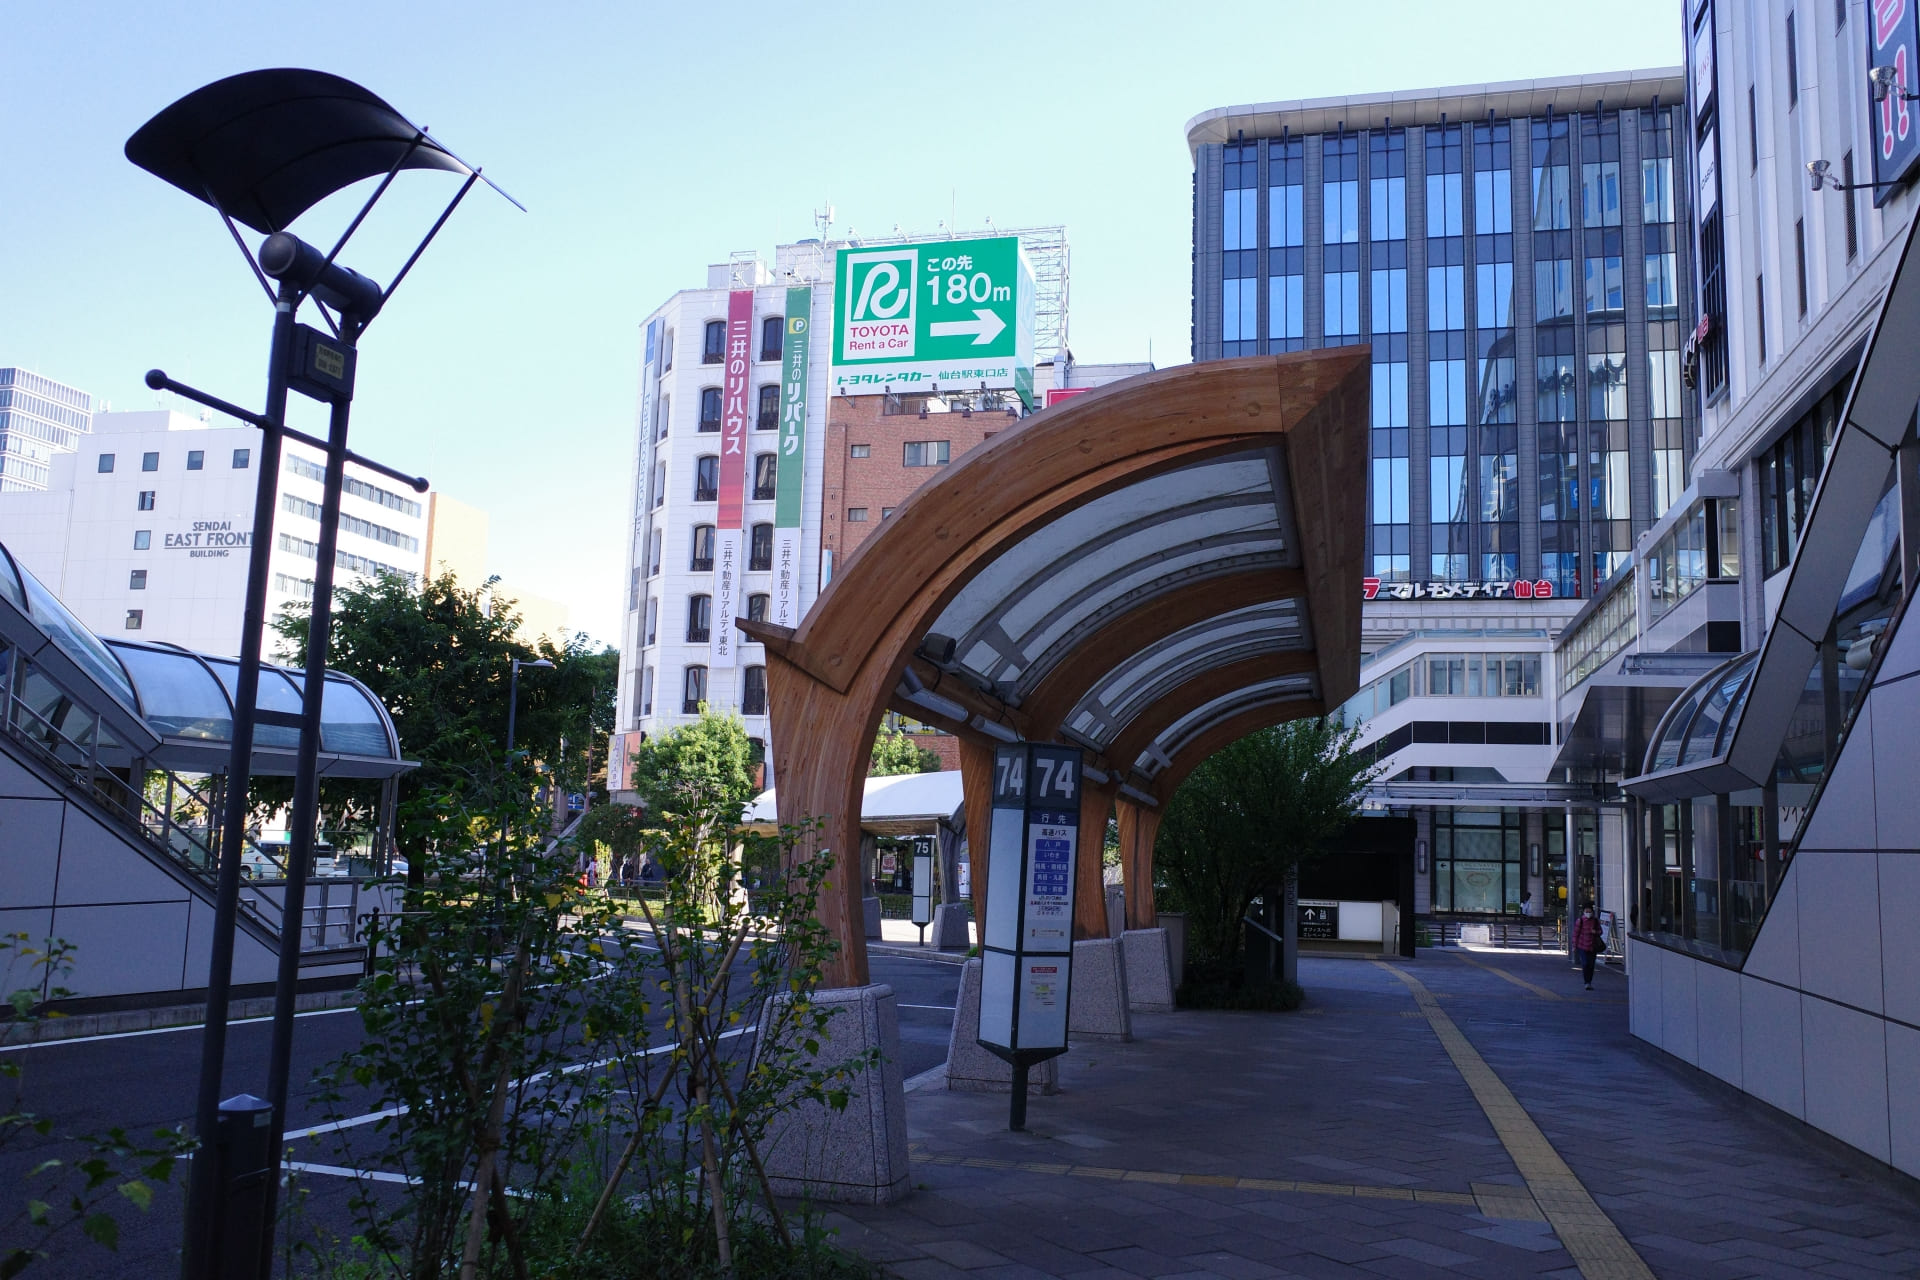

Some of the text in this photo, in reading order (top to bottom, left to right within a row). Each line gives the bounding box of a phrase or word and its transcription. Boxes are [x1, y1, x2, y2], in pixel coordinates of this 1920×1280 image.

[927, 255, 973, 272] この先
[926, 272, 1011, 305] 180m
[850, 324, 909, 338] TOYOTA
[849, 338, 908, 351] Rent a Car
[837, 368, 1008, 385] トヨタレンタカー 仙台駅東口店
[725, 320, 747, 455] 三井のリハウス
[783, 340, 804, 455] 三井のリパーク
[192, 521, 232, 532] SENDAI
[164, 533, 201, 547] EAST
[189, 549, 230, 558] BUILDING
[718, 540, 733, 656] 三井不動産リアルティ東北
[997, 757, 1023, 796] 74
[1036, 758, 1075, 799] 74
[915, 842, 929, 854] 75
